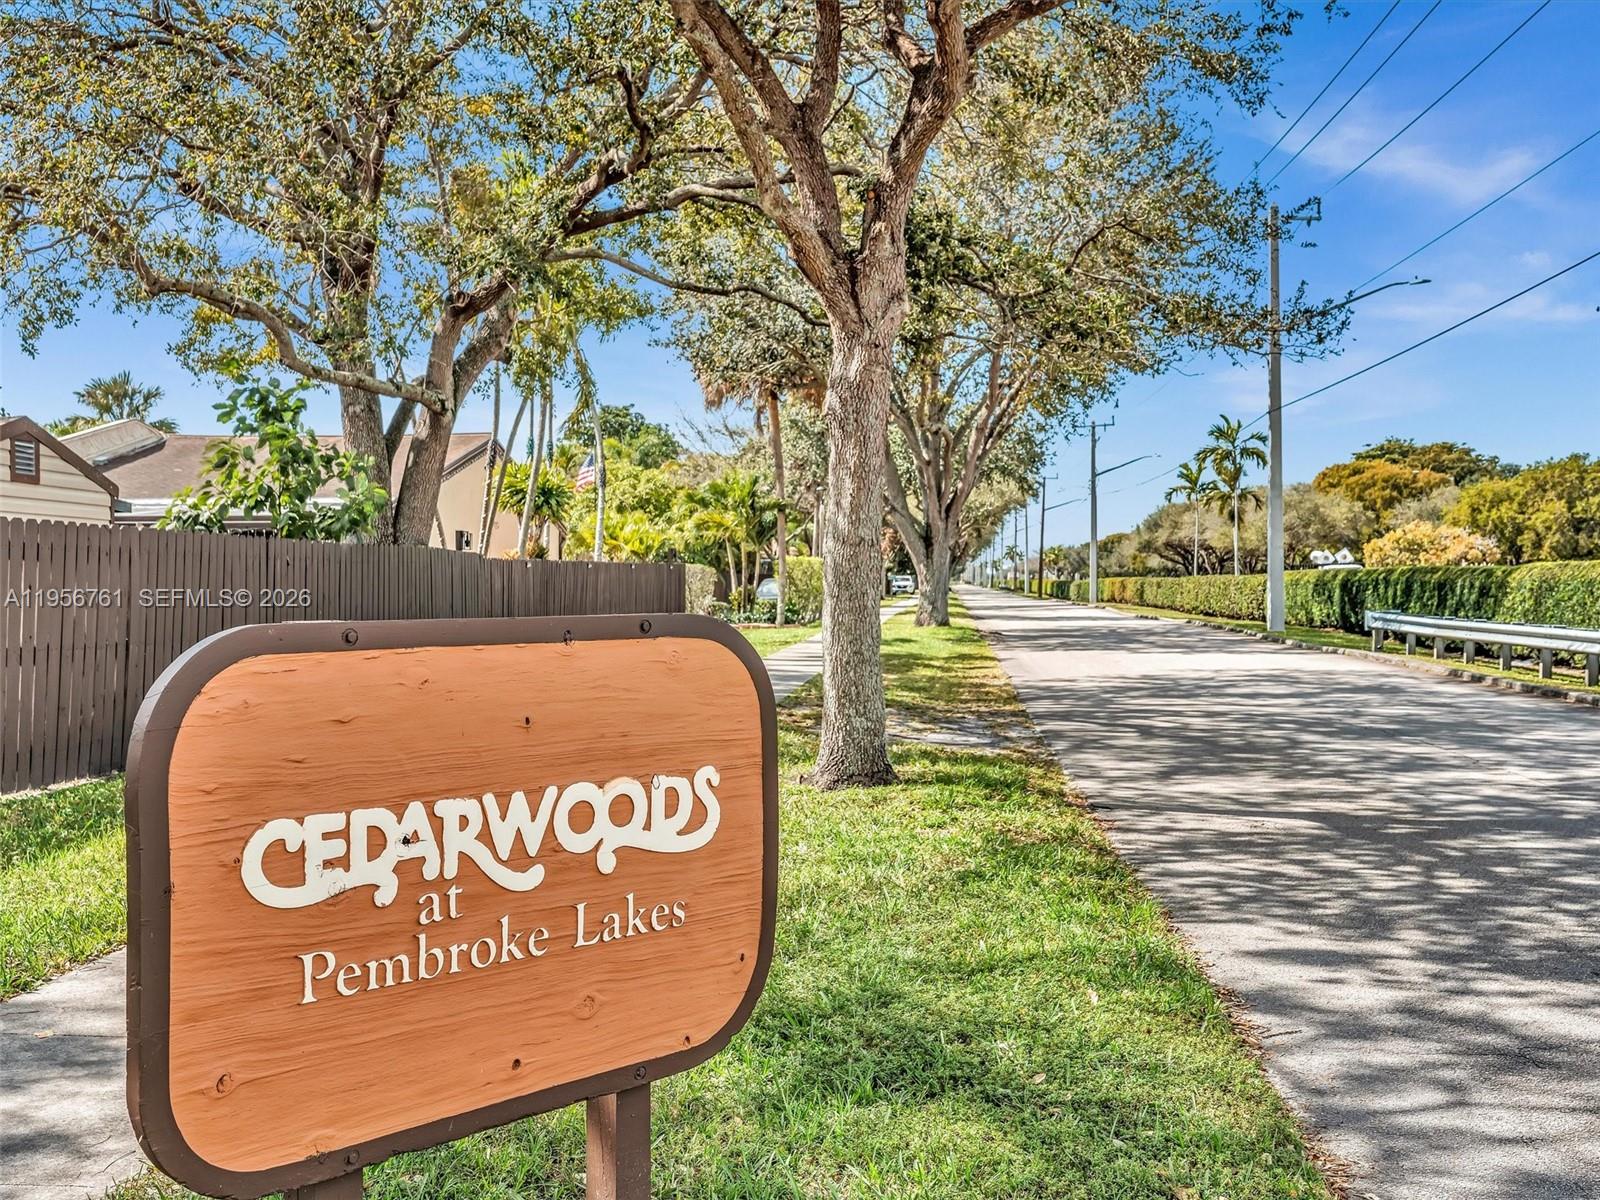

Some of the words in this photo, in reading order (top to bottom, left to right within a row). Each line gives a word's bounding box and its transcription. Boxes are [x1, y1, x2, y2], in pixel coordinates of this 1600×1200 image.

[240, 765, 721, 909] CEDARWOODS
[298, 915, 549, 1004] Pembroke
[572, 892, 686, 948] Lakes
[417, 884, 464, 925] at
